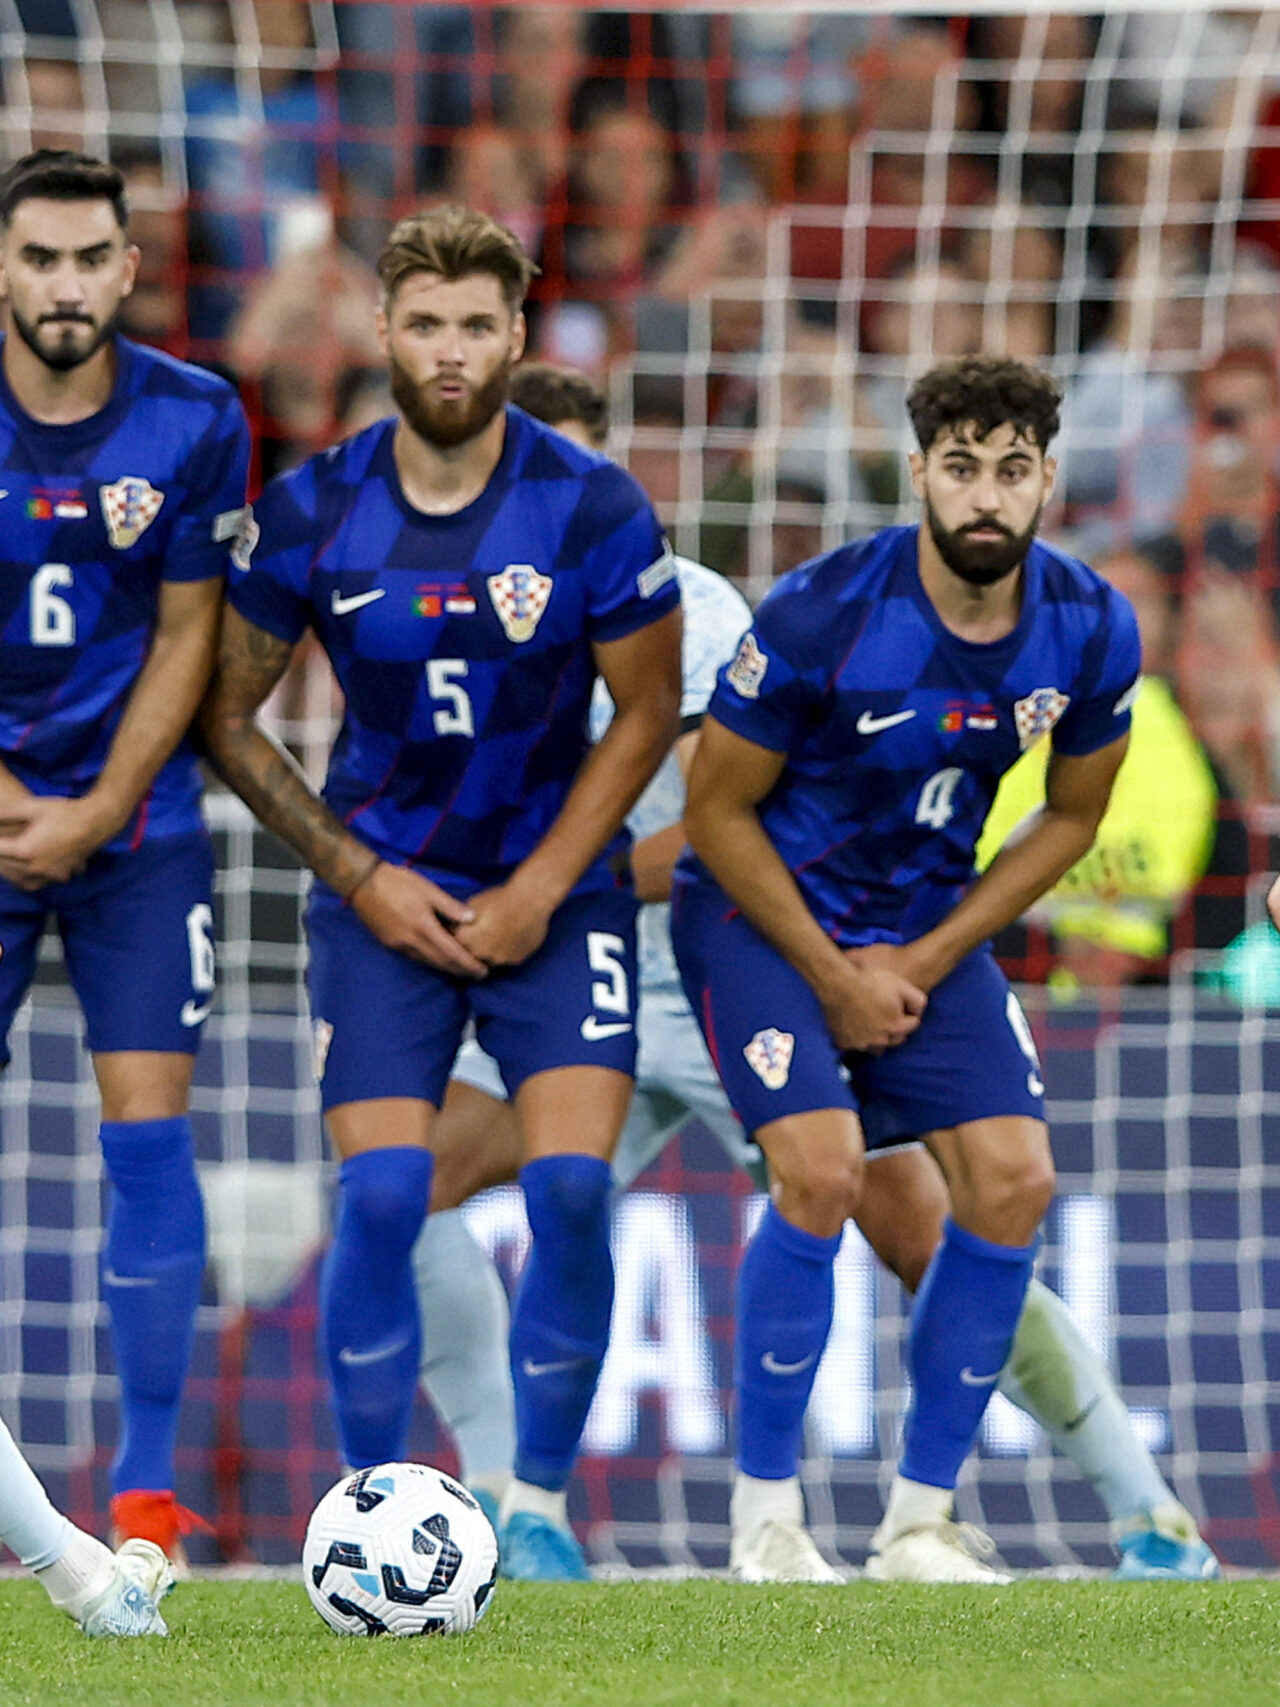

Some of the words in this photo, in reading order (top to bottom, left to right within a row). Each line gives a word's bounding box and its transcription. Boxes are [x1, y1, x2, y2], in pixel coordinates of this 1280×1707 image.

[29, 563, 76, 647] 6
[425, 658, 475, 738] 5
[915, 766, 964, 830] 4
[186, 903, 216, 993] 6
[586, 931, 629, 1015] 5
